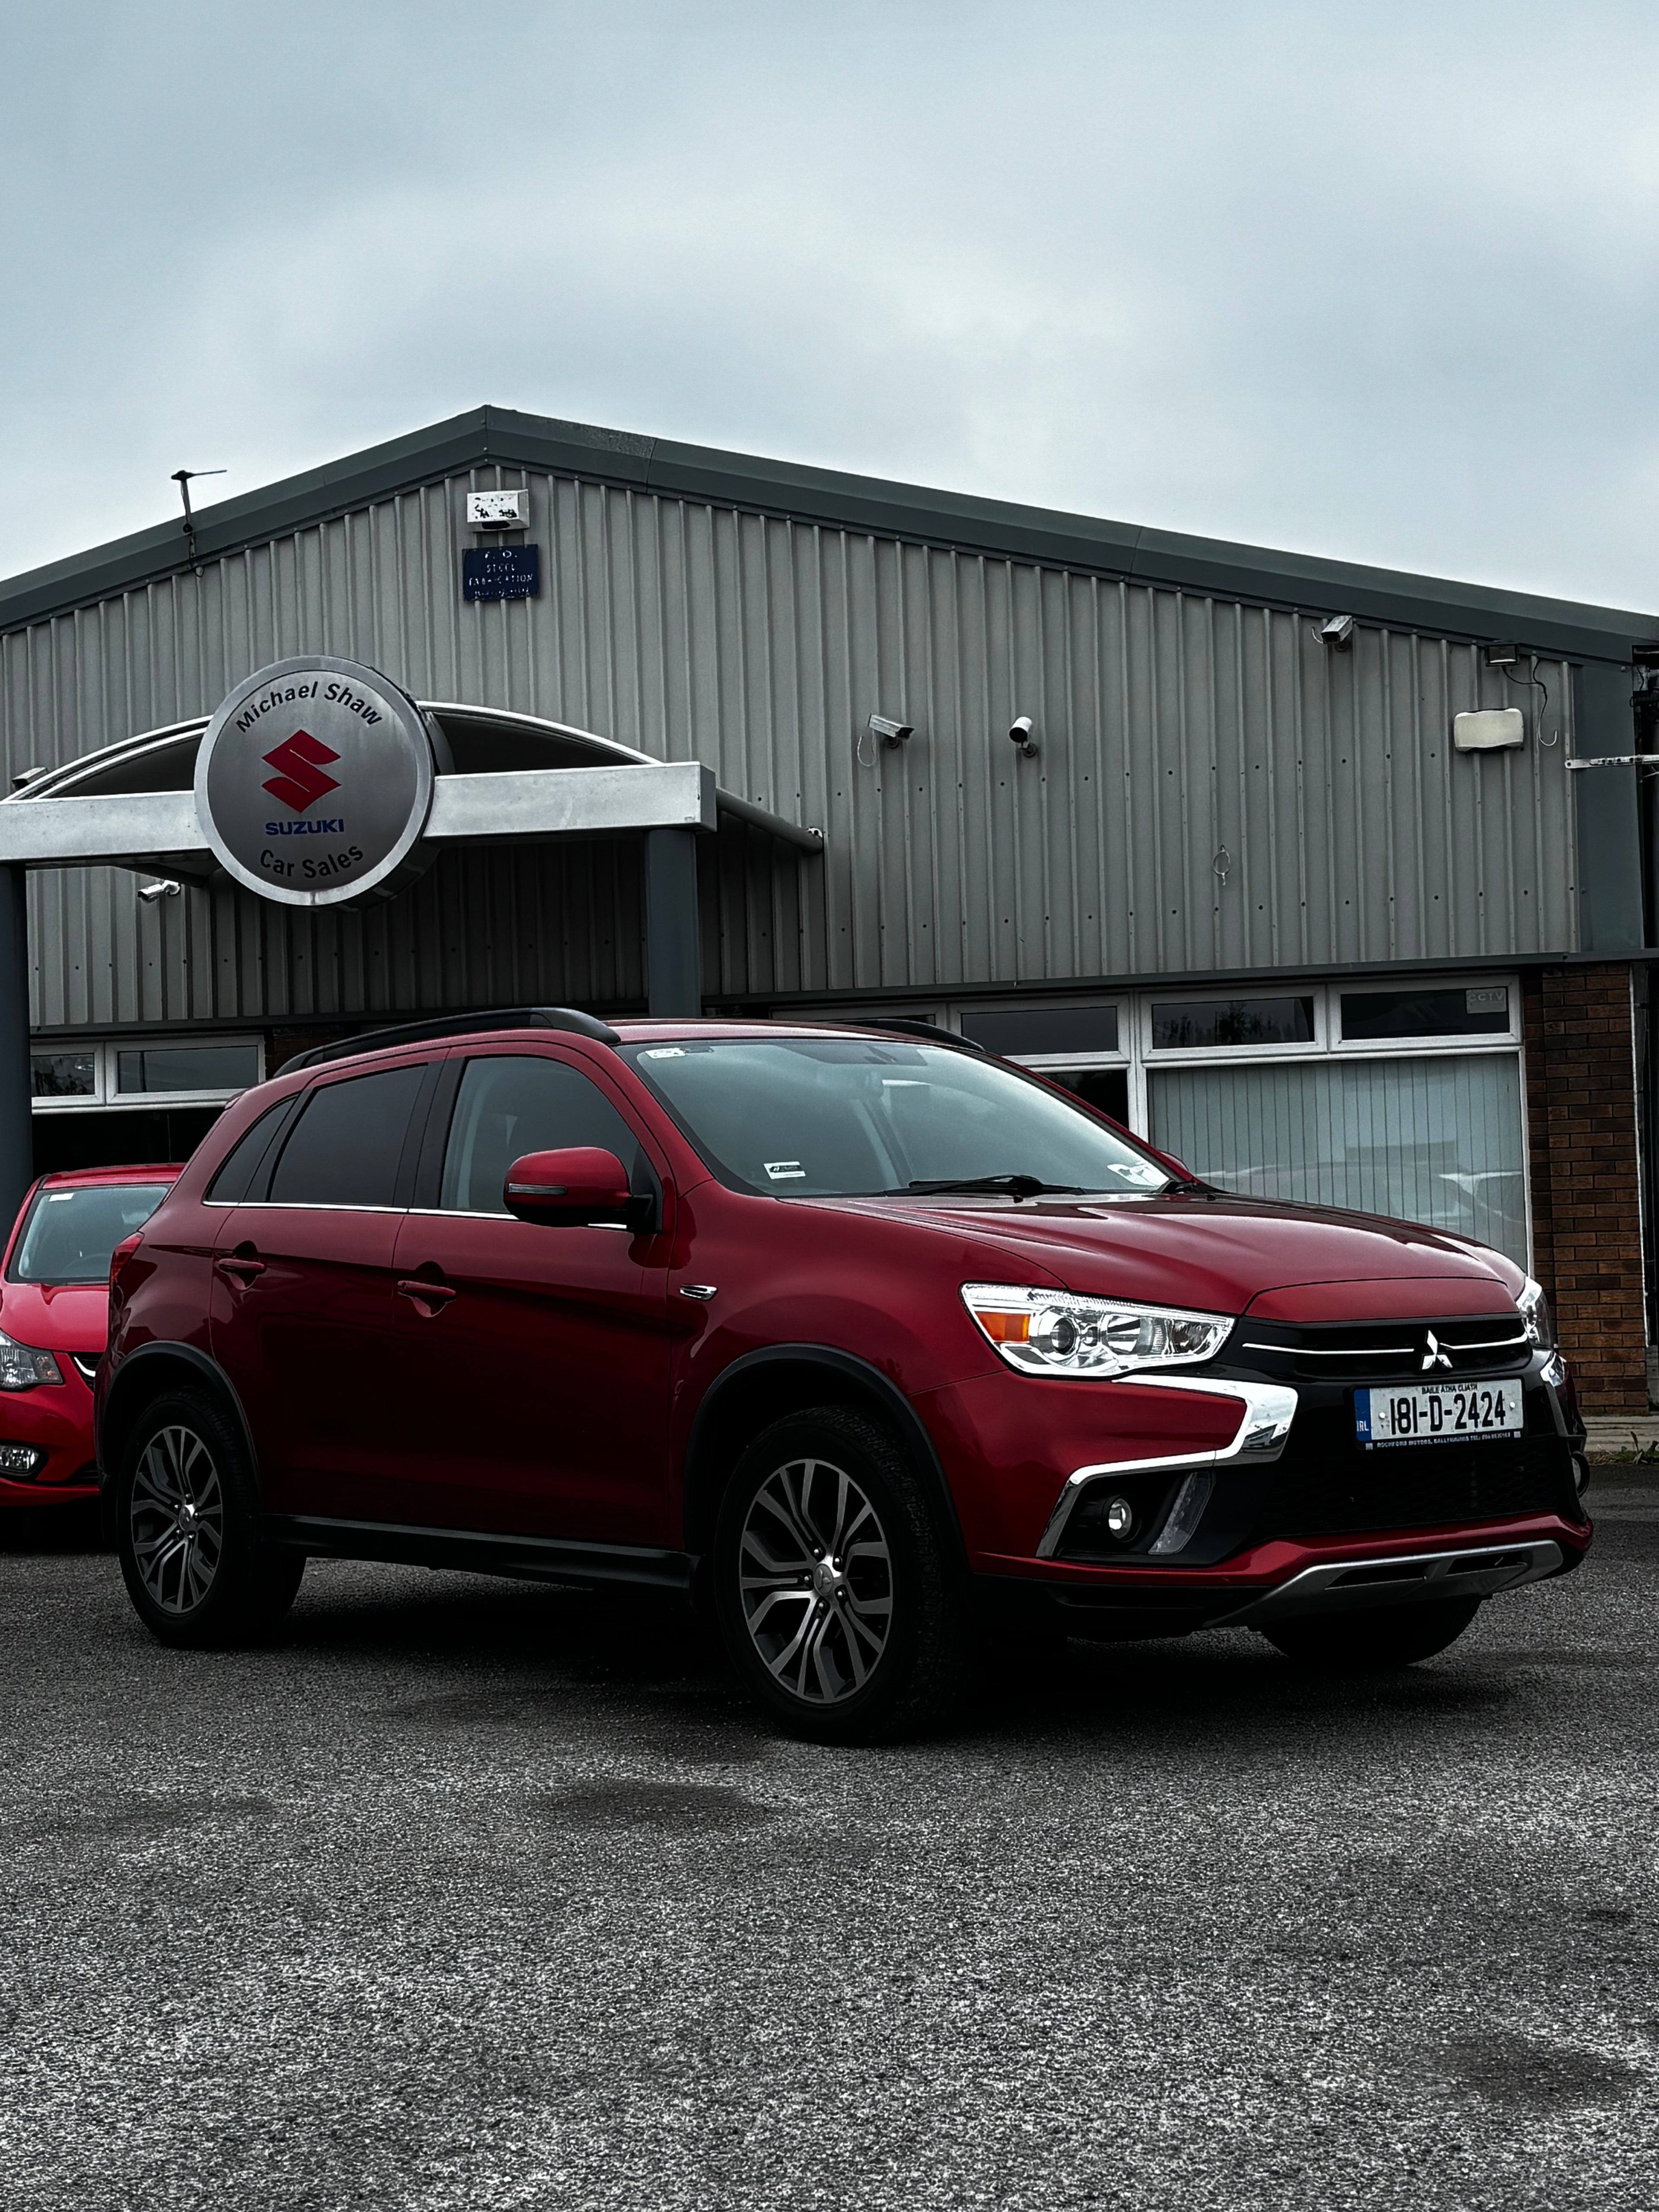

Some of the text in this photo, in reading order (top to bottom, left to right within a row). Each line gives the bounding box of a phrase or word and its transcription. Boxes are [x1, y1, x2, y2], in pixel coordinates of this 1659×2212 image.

[235, 681, 383, 733] Michael Shaw
[265, 819, 345, 836] SUZUKI
[260, 845, 364, 879] Car Sales
[1468, 992, 1503, 1002] CCTV
[1389, 1389, 1506, 1435] 181-D-2424
[1356, 1421, 1370, 1432] IRL
